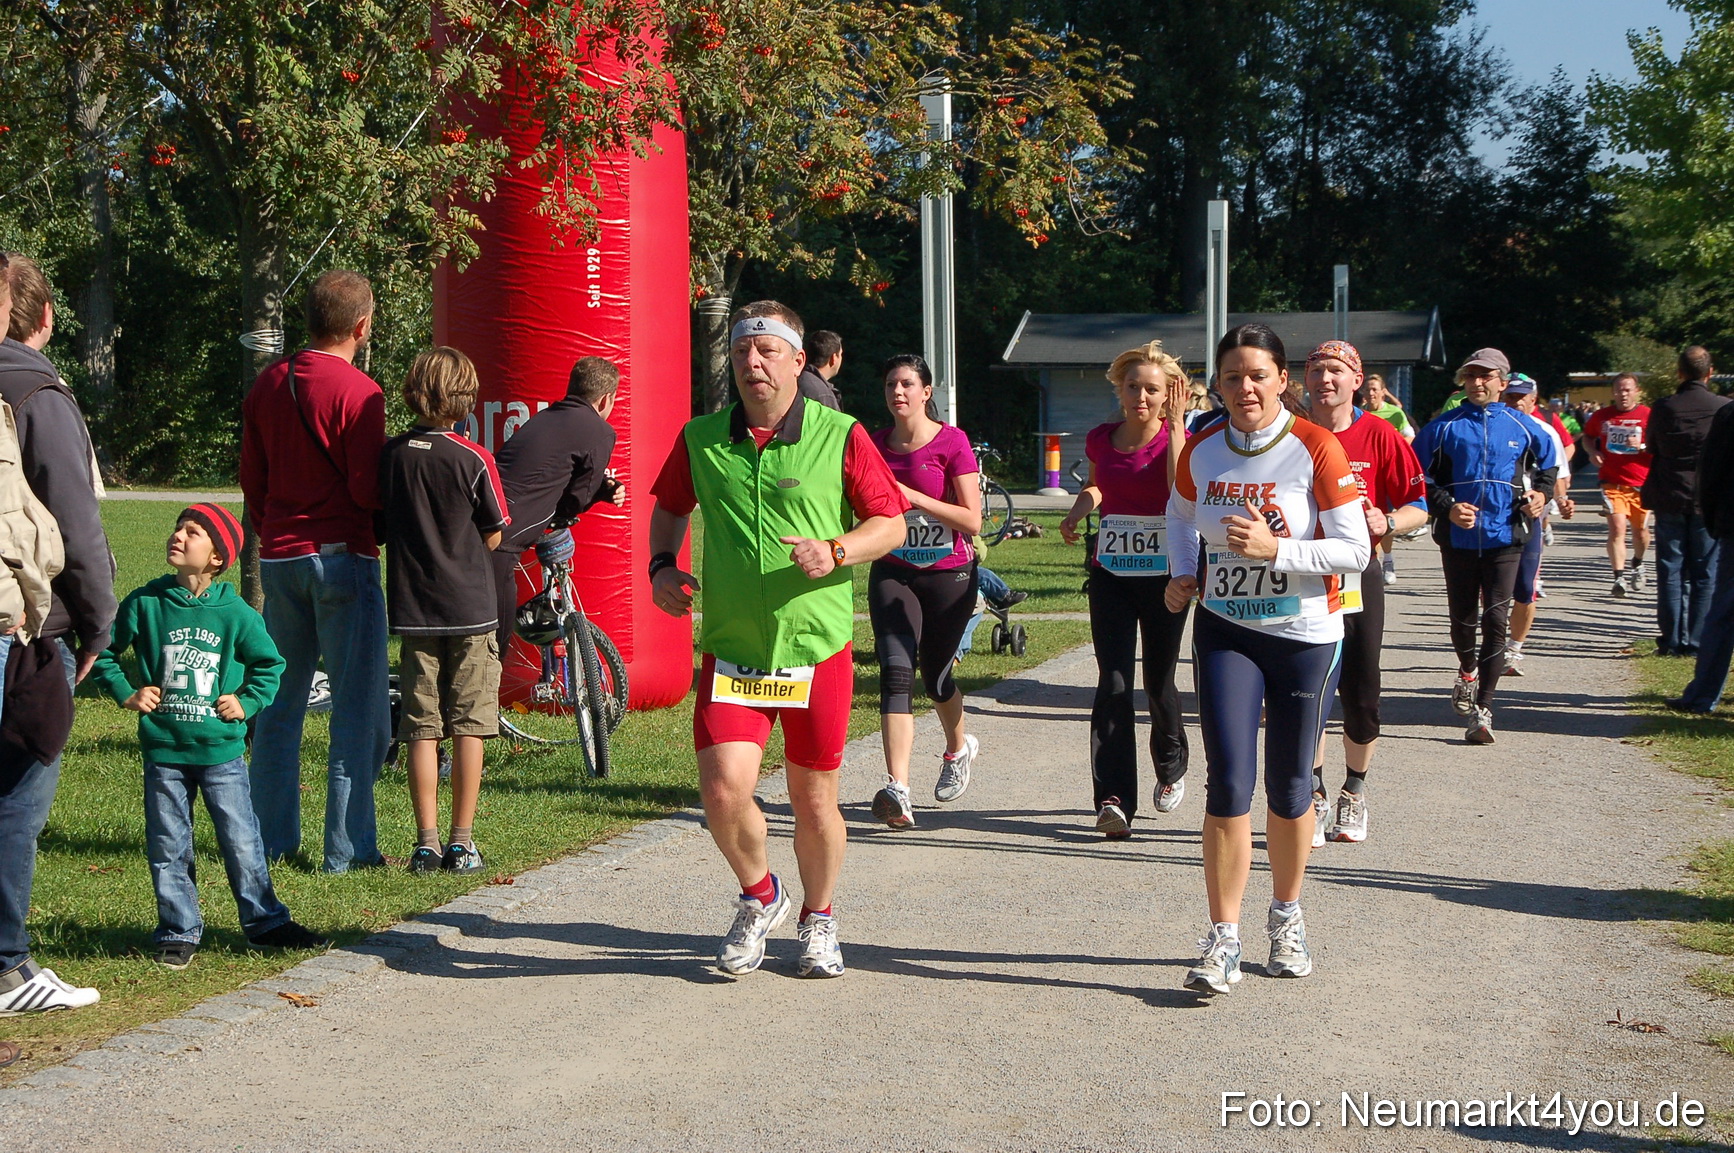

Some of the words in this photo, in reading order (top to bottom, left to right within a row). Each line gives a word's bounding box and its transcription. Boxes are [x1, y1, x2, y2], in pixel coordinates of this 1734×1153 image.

[587, 248, 601, 279] 1929
[587, 284, 601, 308] Seit
[1207, 481, 1276, 499] MERZ
[901, 526, 945, 548] 022
[1105, 526, 1160, 553] 2164
[902, 550, 937, 561] Katrin
[1111, 555, 1153, 568] Andrea
[1214, 565, 1288, 598] 3279
[1226, 600, 1276, 619] Sylvia
[168, 628, 192, 643] EST.
[195, 628, 220, 647] 1993
[181, 648, 210, 669] 1993
[731, 678, 795, 697] Guenter
